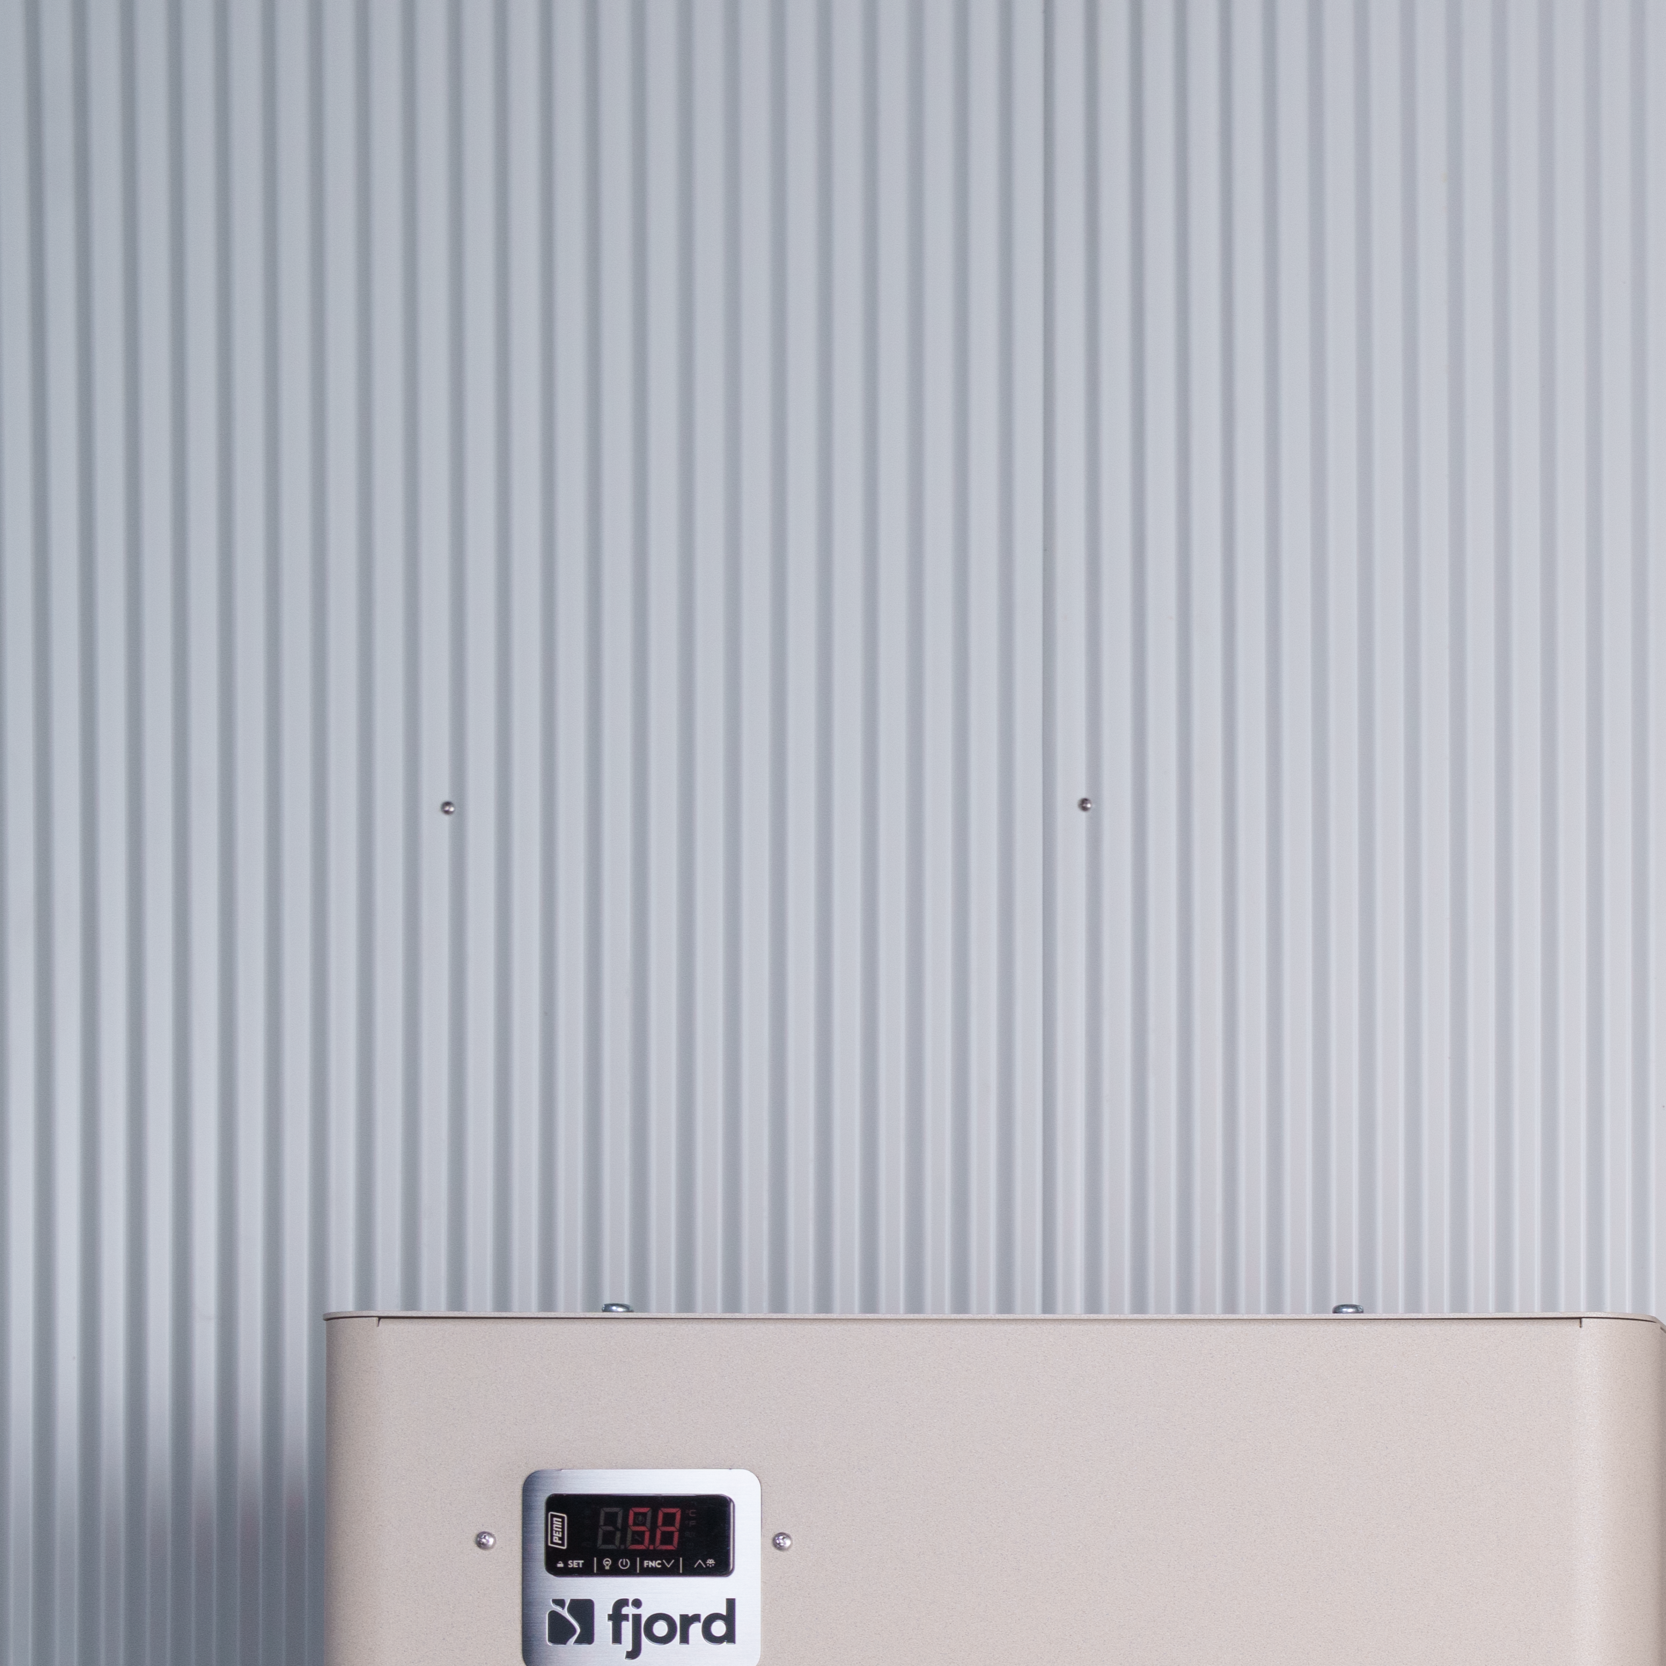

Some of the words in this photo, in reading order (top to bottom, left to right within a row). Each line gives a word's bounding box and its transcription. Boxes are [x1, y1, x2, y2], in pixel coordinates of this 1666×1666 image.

[552, 1517, 562, 1544] PENN
[568, 1560, 585, 1568] SET
[643, 1560, 662, 1568] FNC
[607, 1598, 736, 1660] fjord
